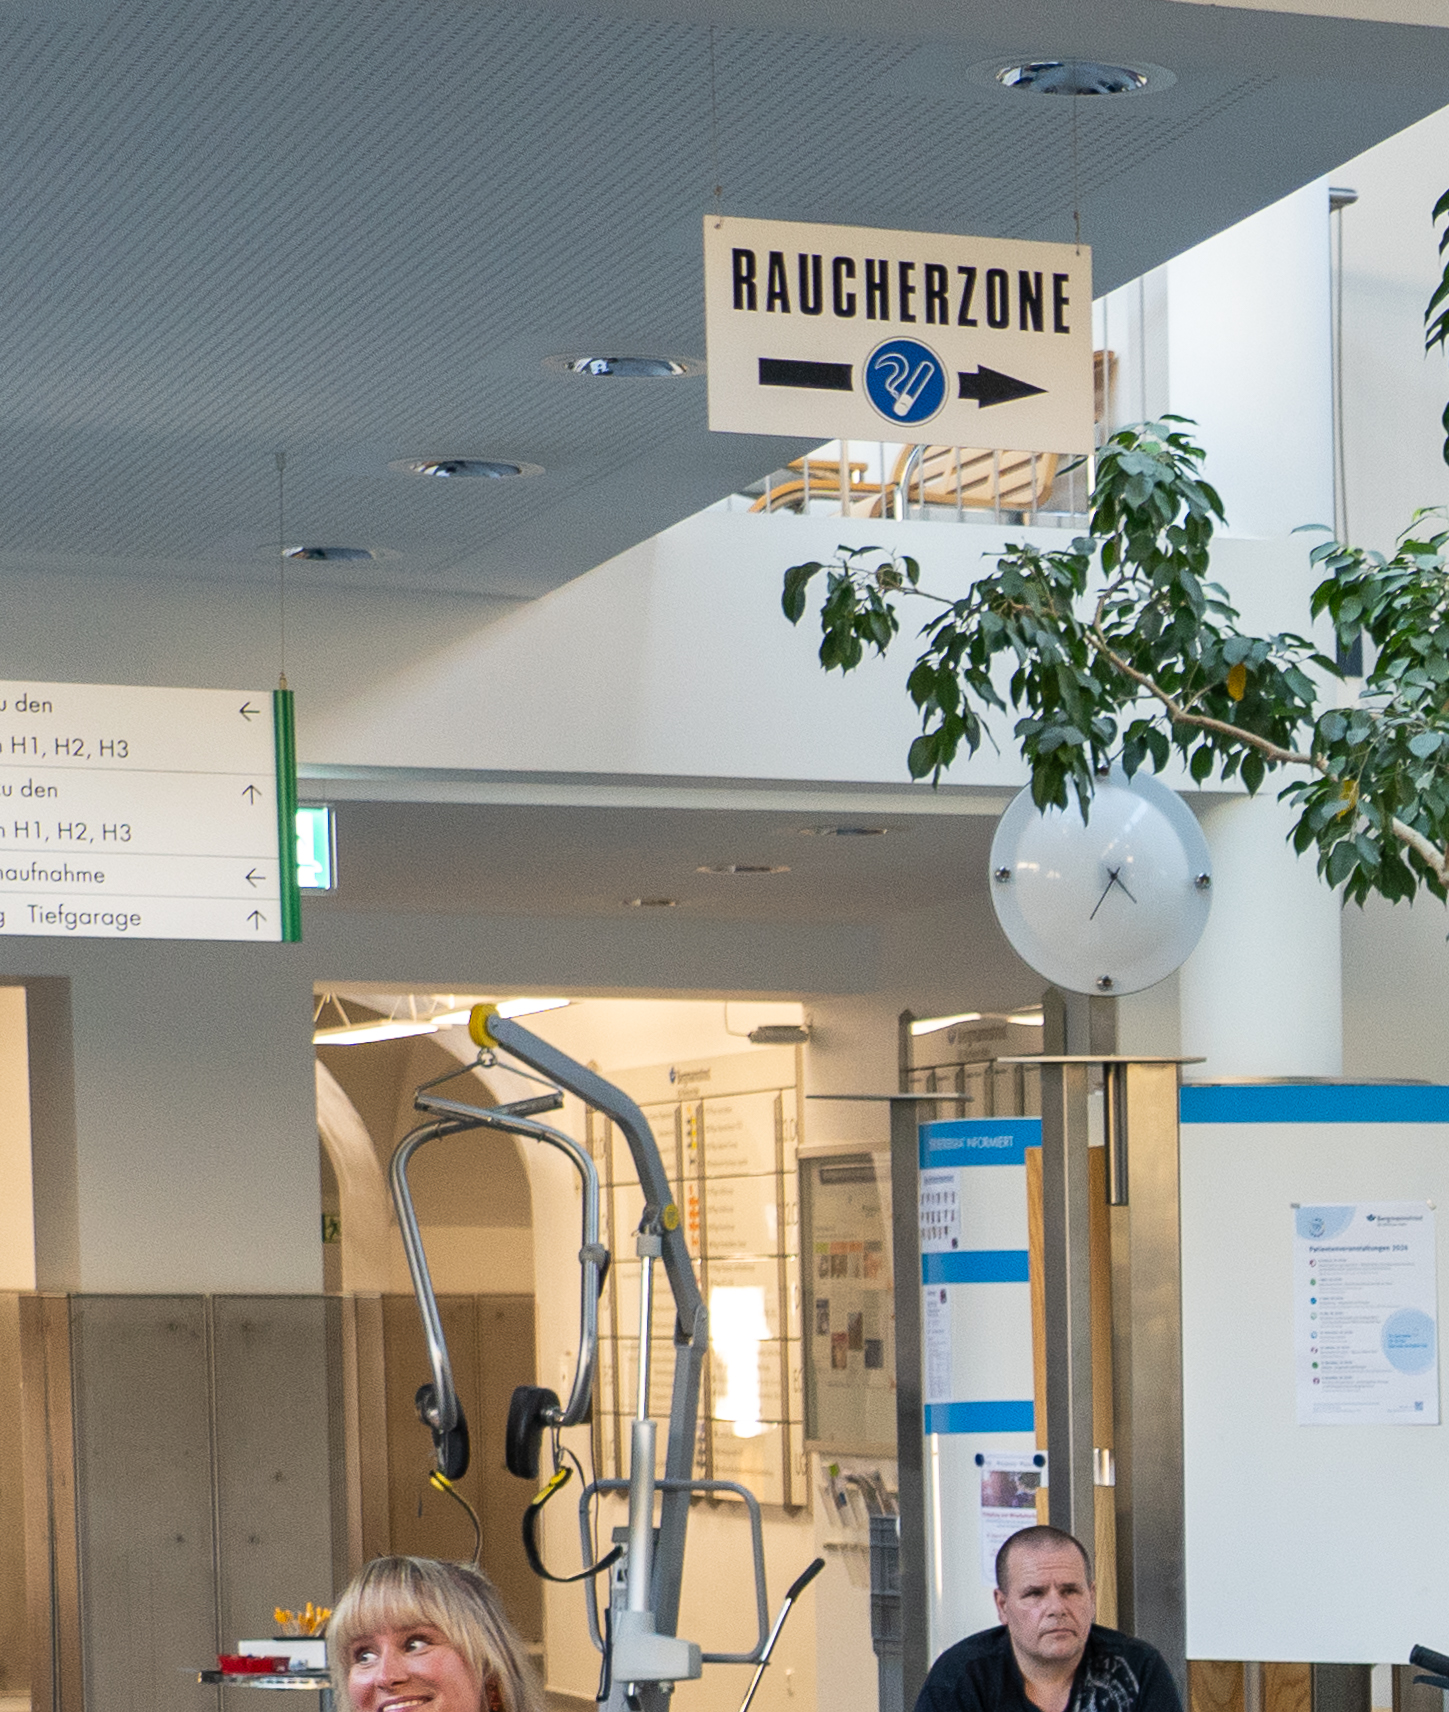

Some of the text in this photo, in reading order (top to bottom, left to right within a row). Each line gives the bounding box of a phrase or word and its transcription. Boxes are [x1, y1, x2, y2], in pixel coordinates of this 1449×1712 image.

[732, 248, 1071, 334] RAUCHERZONE
[15, 693, 53, 713] den
[11, 736, 46, 758] H1,
[54, 738, 91, 760] H2,
[99, 739, 129, 758] H3
[21, 778, 58, 798] den
[14, 821, 49, 842] H1,
[57, 822, 94, 844] H2,
[102, 824, 132, 842] H3
[27, 904, 141, 931] Tiefgarage
